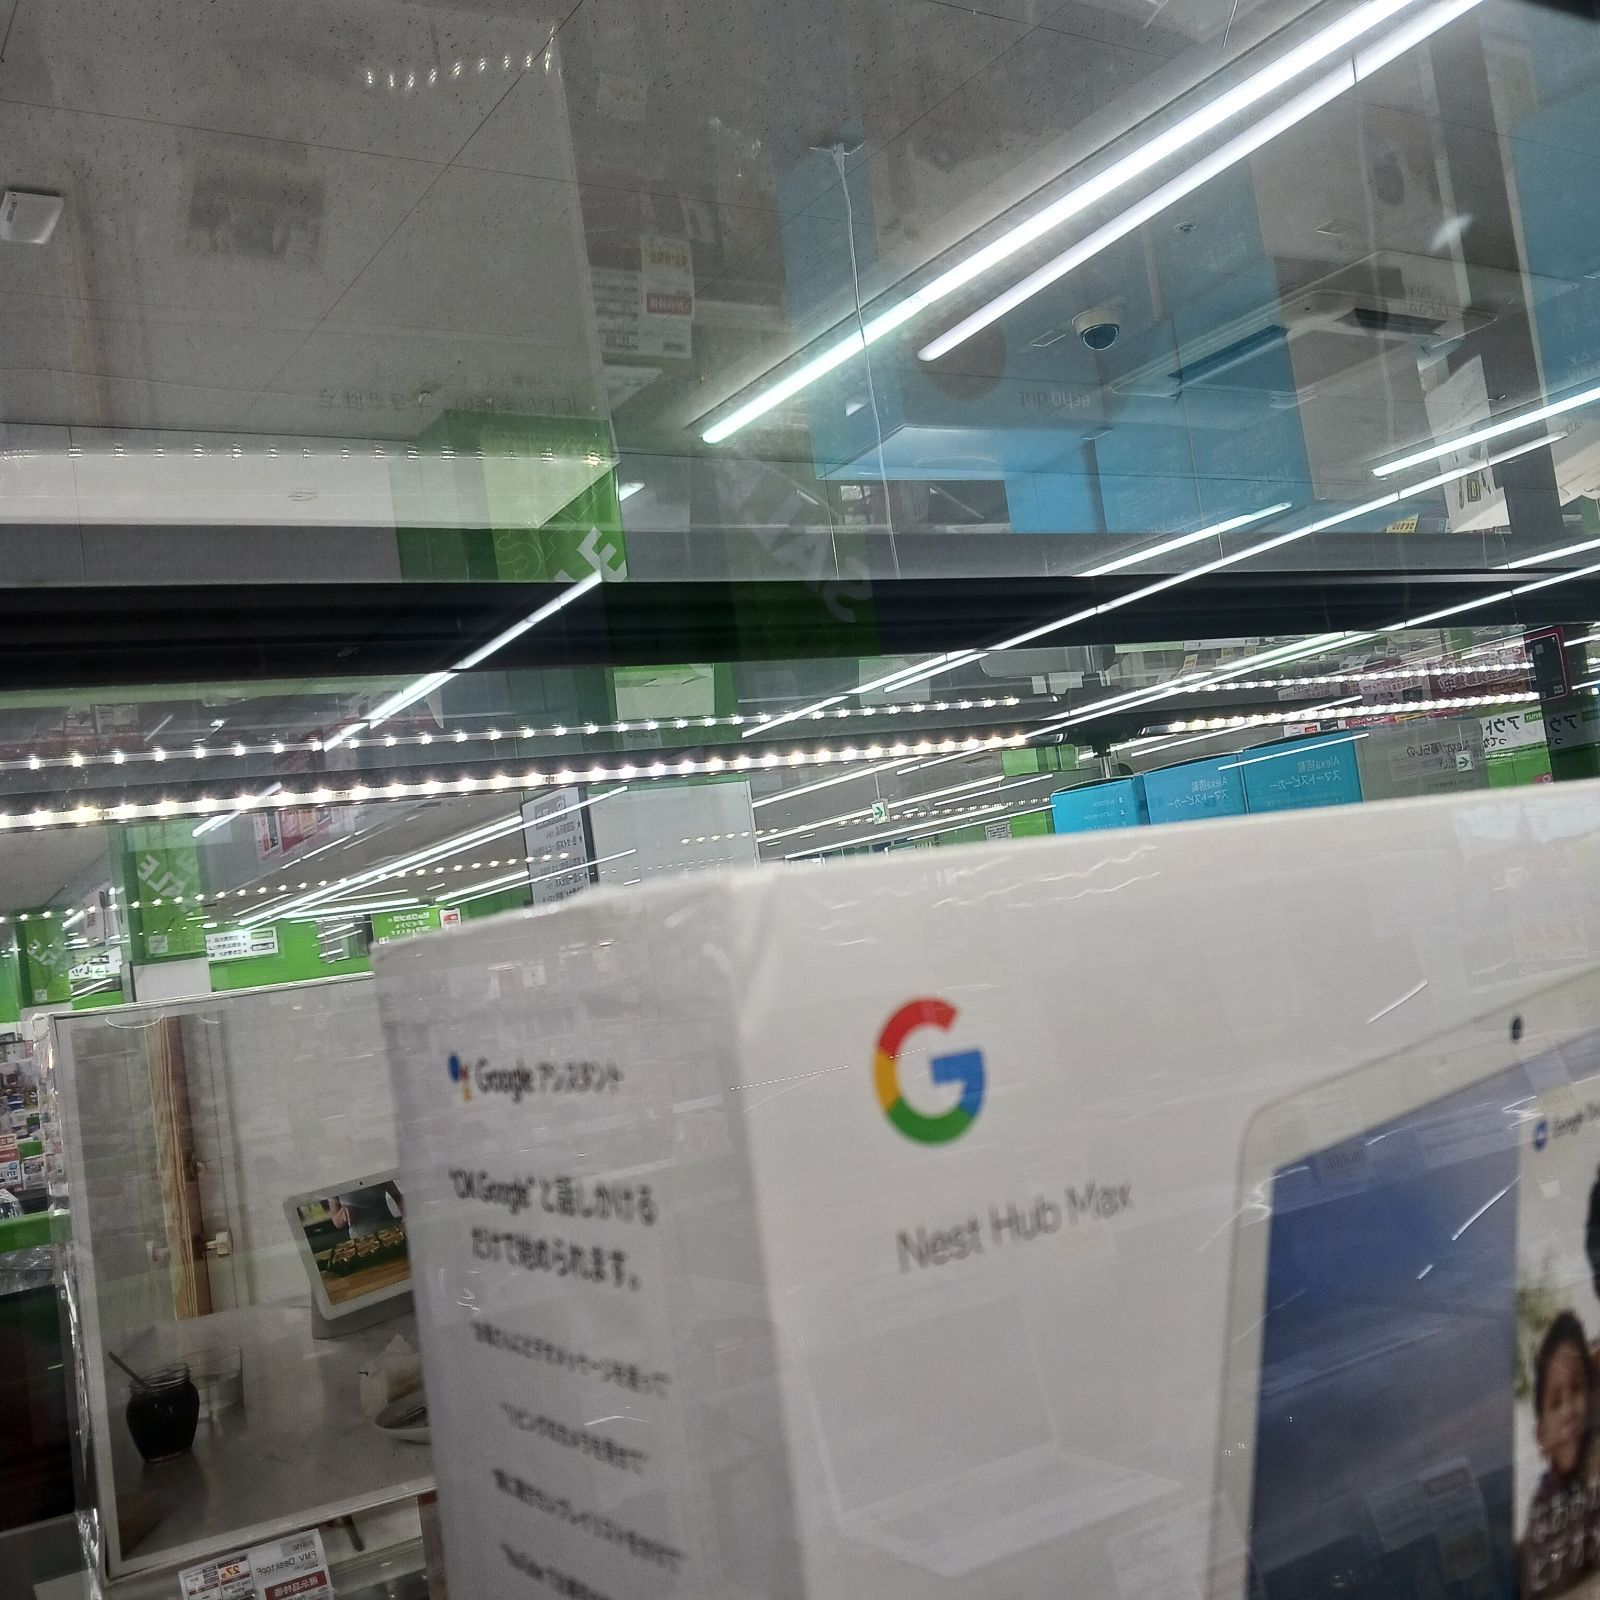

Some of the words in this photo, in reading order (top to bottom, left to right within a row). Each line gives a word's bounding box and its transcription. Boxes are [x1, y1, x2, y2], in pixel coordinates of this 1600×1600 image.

[474, 1057, 535, 1103] Google
[874, 997, 986, 1145] G
[895, 1217, 984, 1273] Nest
[988, 1192, 1064, 1245] Hub
[1065, 1178, 1135, 1227] Max
